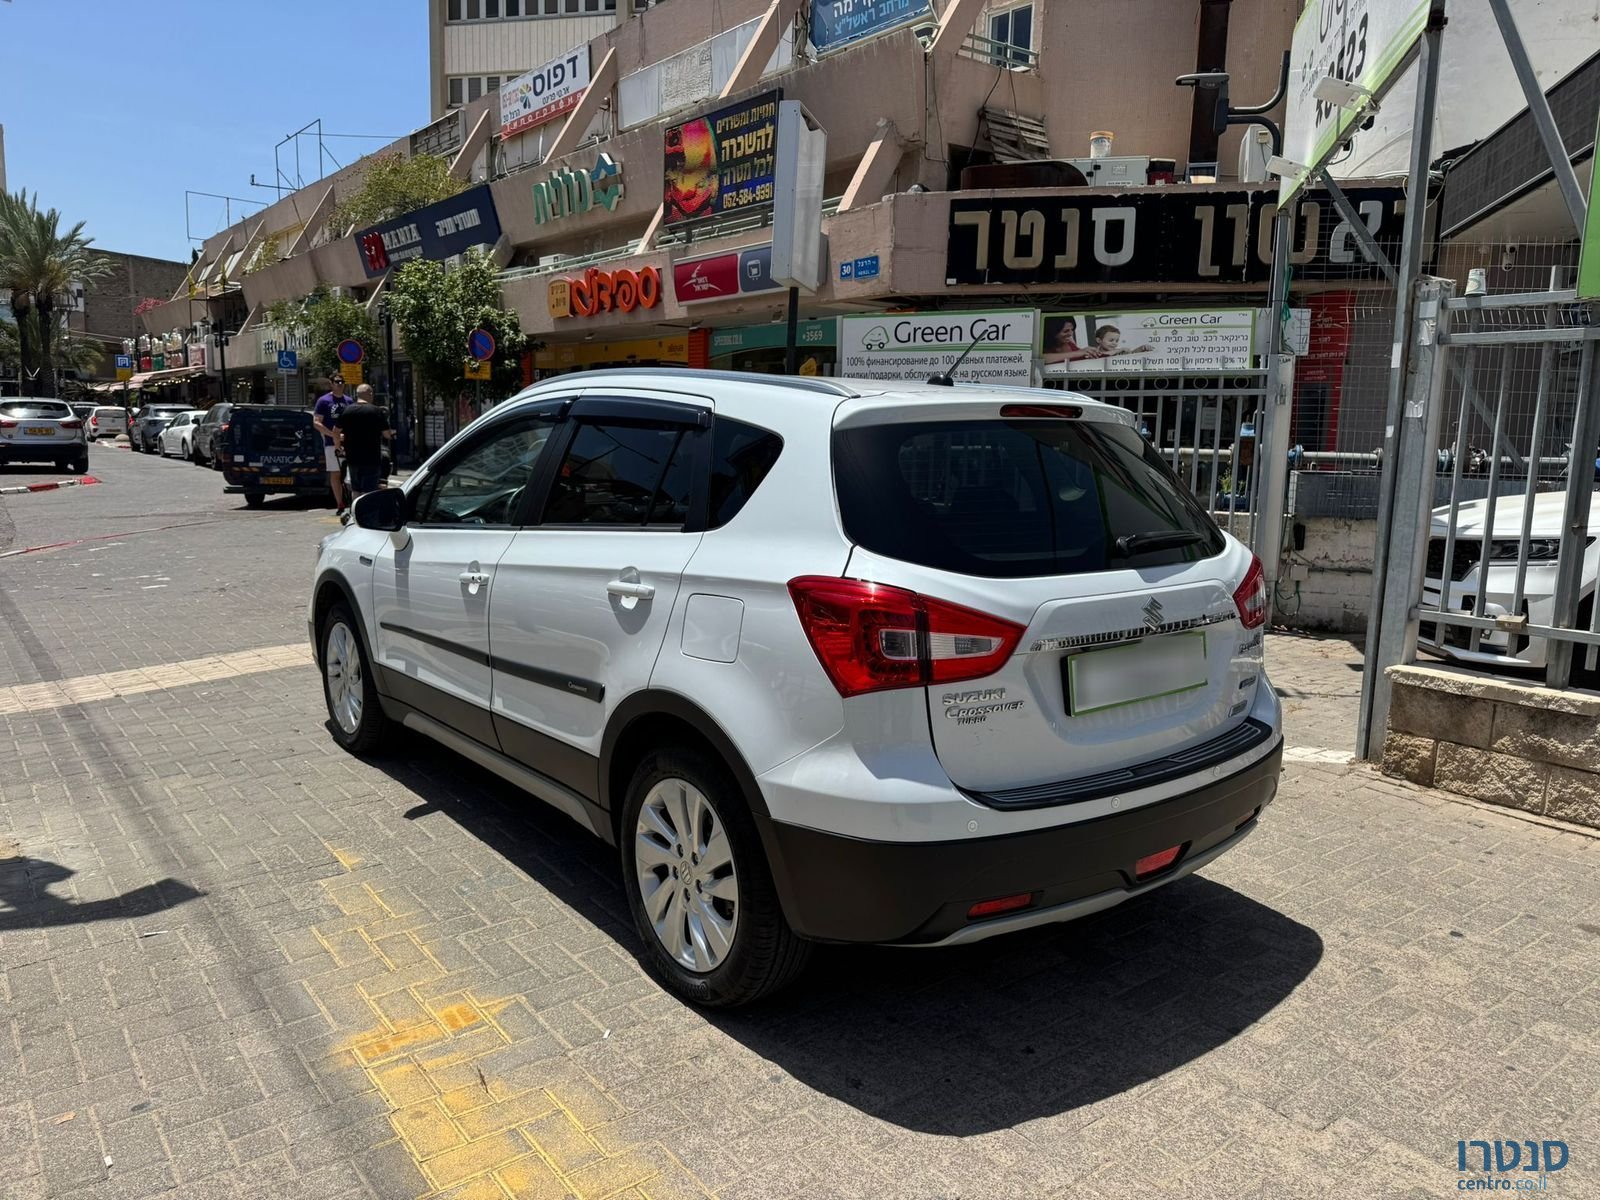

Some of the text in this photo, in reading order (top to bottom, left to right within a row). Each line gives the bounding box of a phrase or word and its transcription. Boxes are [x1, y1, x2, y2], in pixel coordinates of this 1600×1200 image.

[532, 54, 578, 97] דפוס
[721, 122, 775, 163] להשכרה
[723, 153, 774, 186] לכל מטרה
[532, 166, 594, 225] כללית
[381, 223, 422, 251] MANIA
[954, 207, 1137, 270] סנטר
[841, 265, 851, 276] 30
[1159, 313, 1222, 326] Green Car
[894, 319, 1011, 344] Green Car
[846, 356, 866, 367] 100%
[866, 356, 928, 368] финансирование
[929, 357, 939, 368] до
[941, 355, 955, 366] 100
[985, 355, 1024, 366] платежей.
[959, 370, 969, 378] на
[971, 369, 1004, 382] русском
[1004, 368, 1029, 378] языке.
[260, 455, 294, 464] FANATIC
[942, 687, 1006, 705] SUZUKI
[957, 715, 987, 725] TURBO
